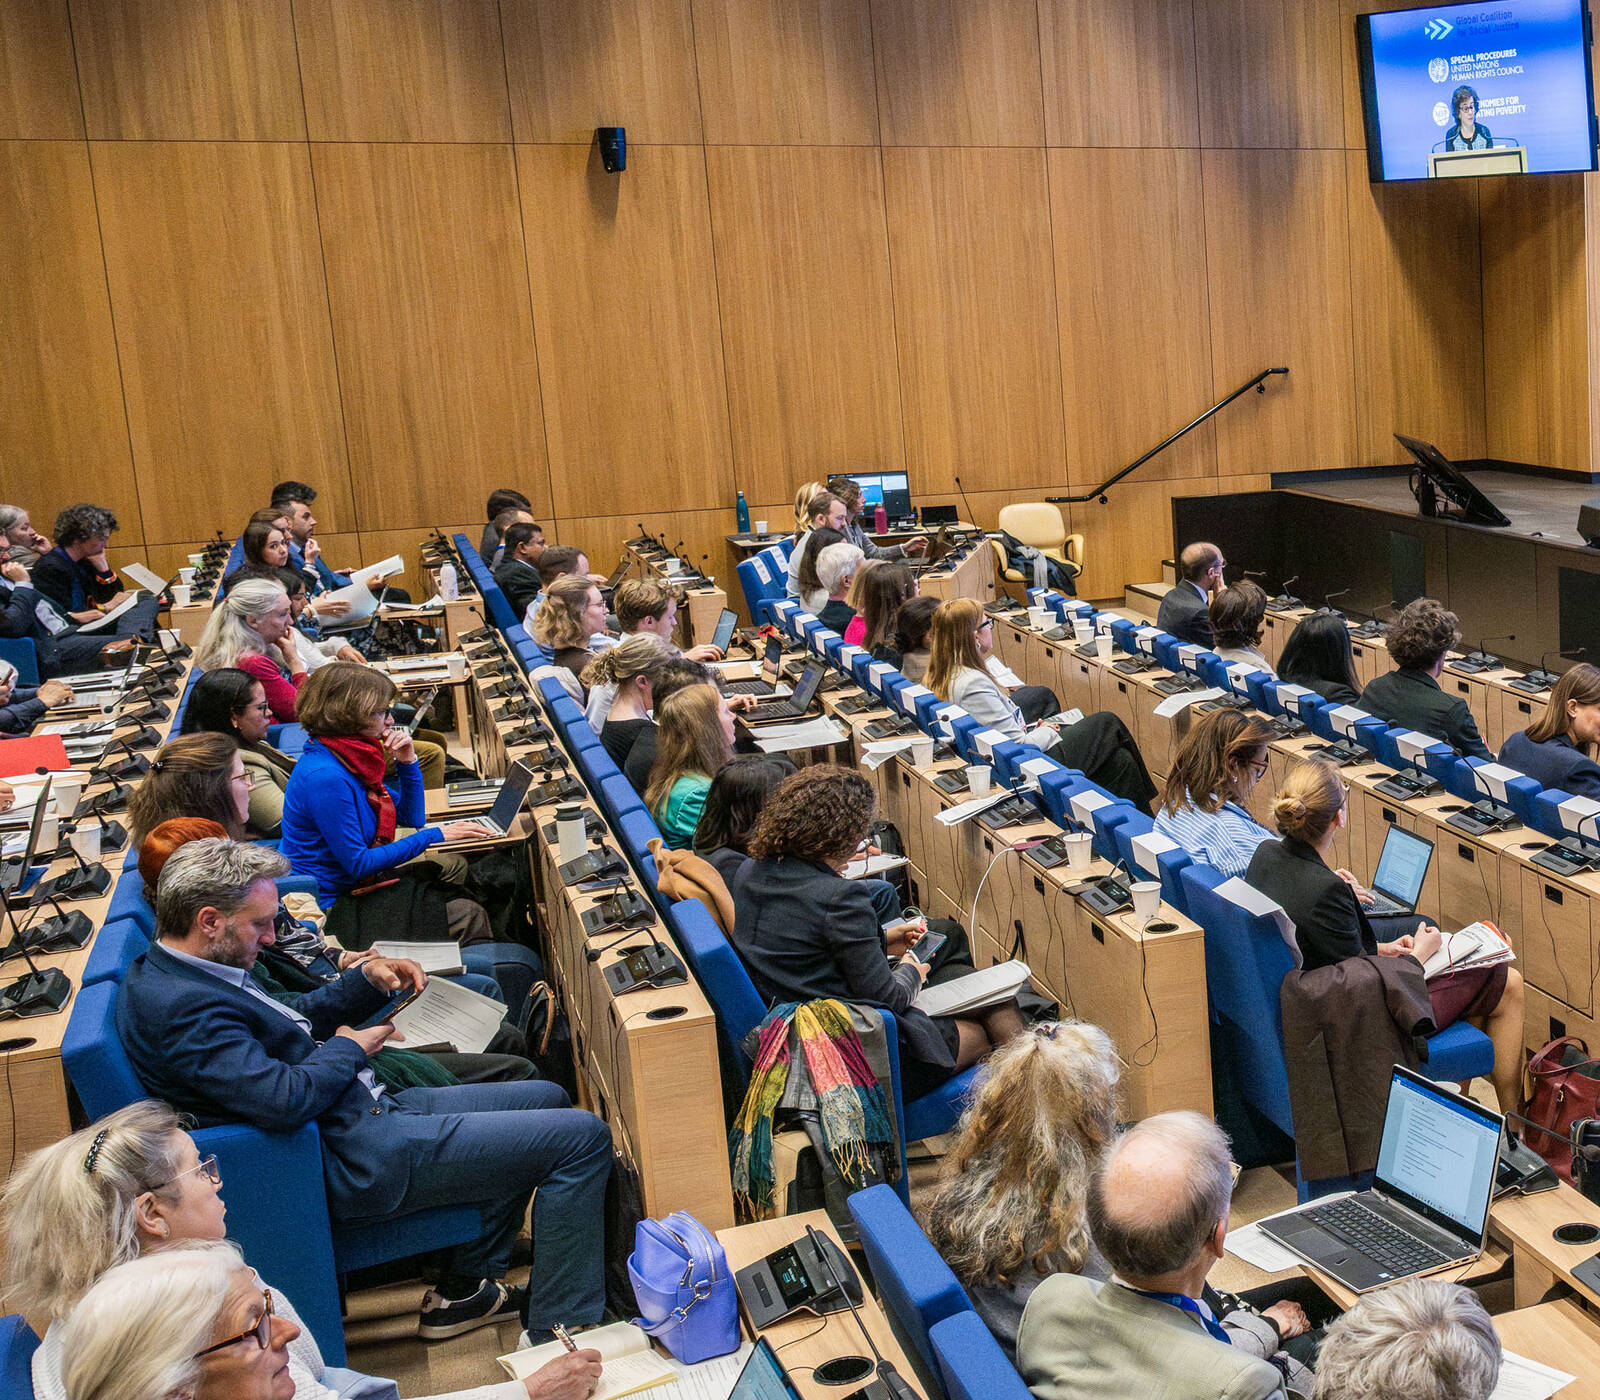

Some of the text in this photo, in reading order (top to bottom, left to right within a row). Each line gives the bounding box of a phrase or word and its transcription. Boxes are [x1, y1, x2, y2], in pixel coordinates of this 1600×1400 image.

[1451, 48, 1517, 65] SPECIAL PROCEDURES
[1451, 60, 1500, 73] UNITED NATIONS
[1451, 71, 1475, 82] HUMAN
[1496, 65, 1524, 76] COUNCIL
[1506, 95, 1520, 106] FOR
